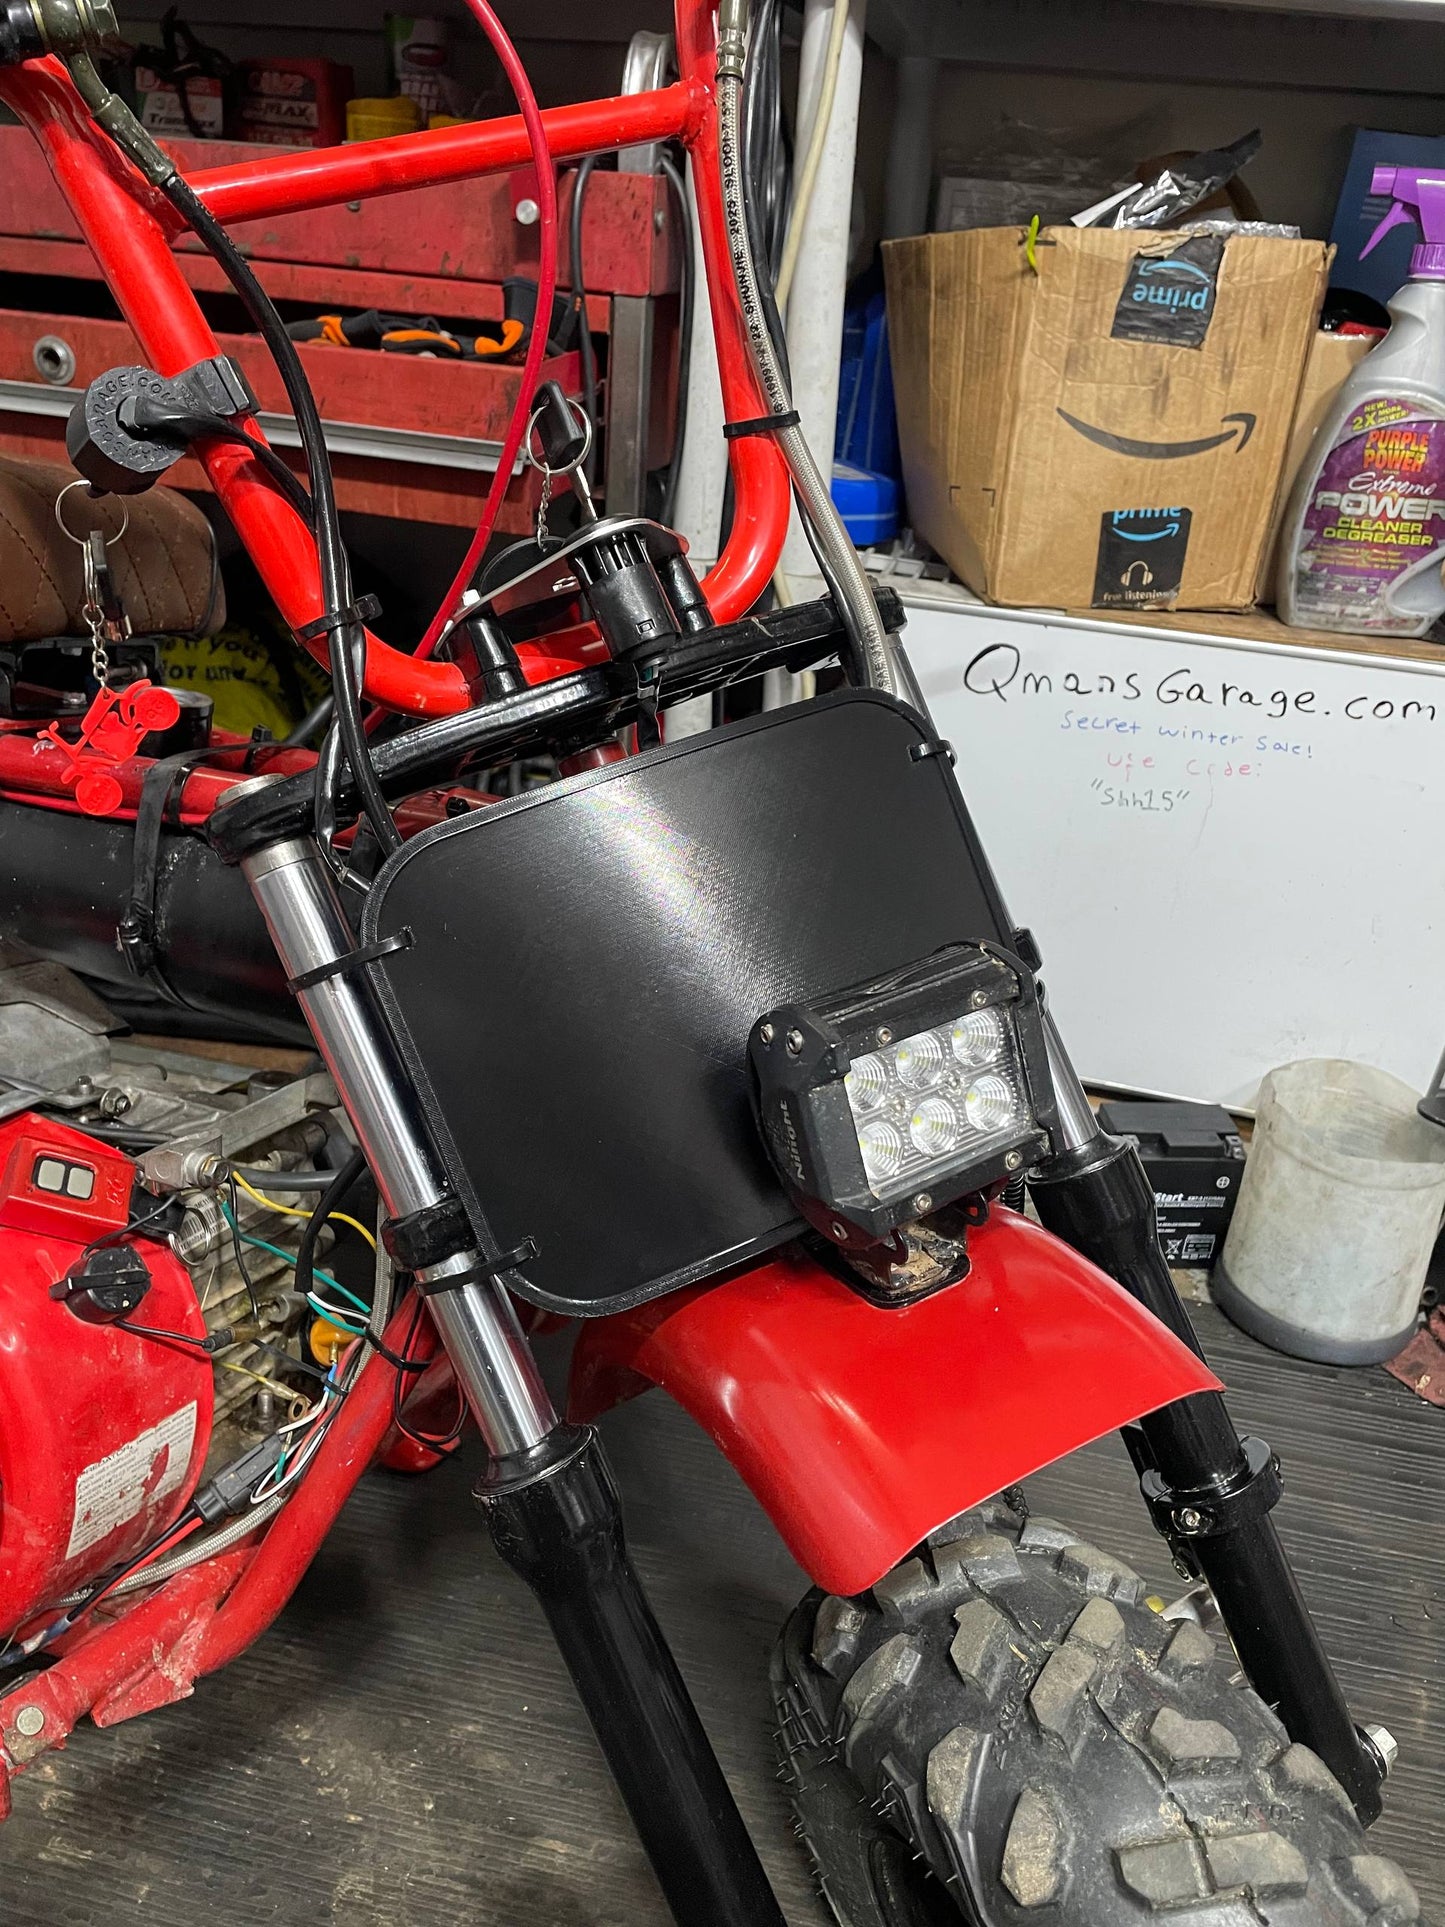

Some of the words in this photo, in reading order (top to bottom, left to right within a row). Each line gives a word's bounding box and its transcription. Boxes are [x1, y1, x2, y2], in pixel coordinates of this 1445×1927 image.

[1132, 283, 1209, 314] prime
[1352, 412, 1377, 431] 2X
[1365, 430, 1430, 452] PURPLE
[1363, 448, 1427, 473] POWER
[1348, 471, 1438, 496] Extreme
[1337, 517, 1423, 534] CLEANER
[1323, 528, 1434, 546] DEGREASER
[1158, 725, 1244, 746] winter
